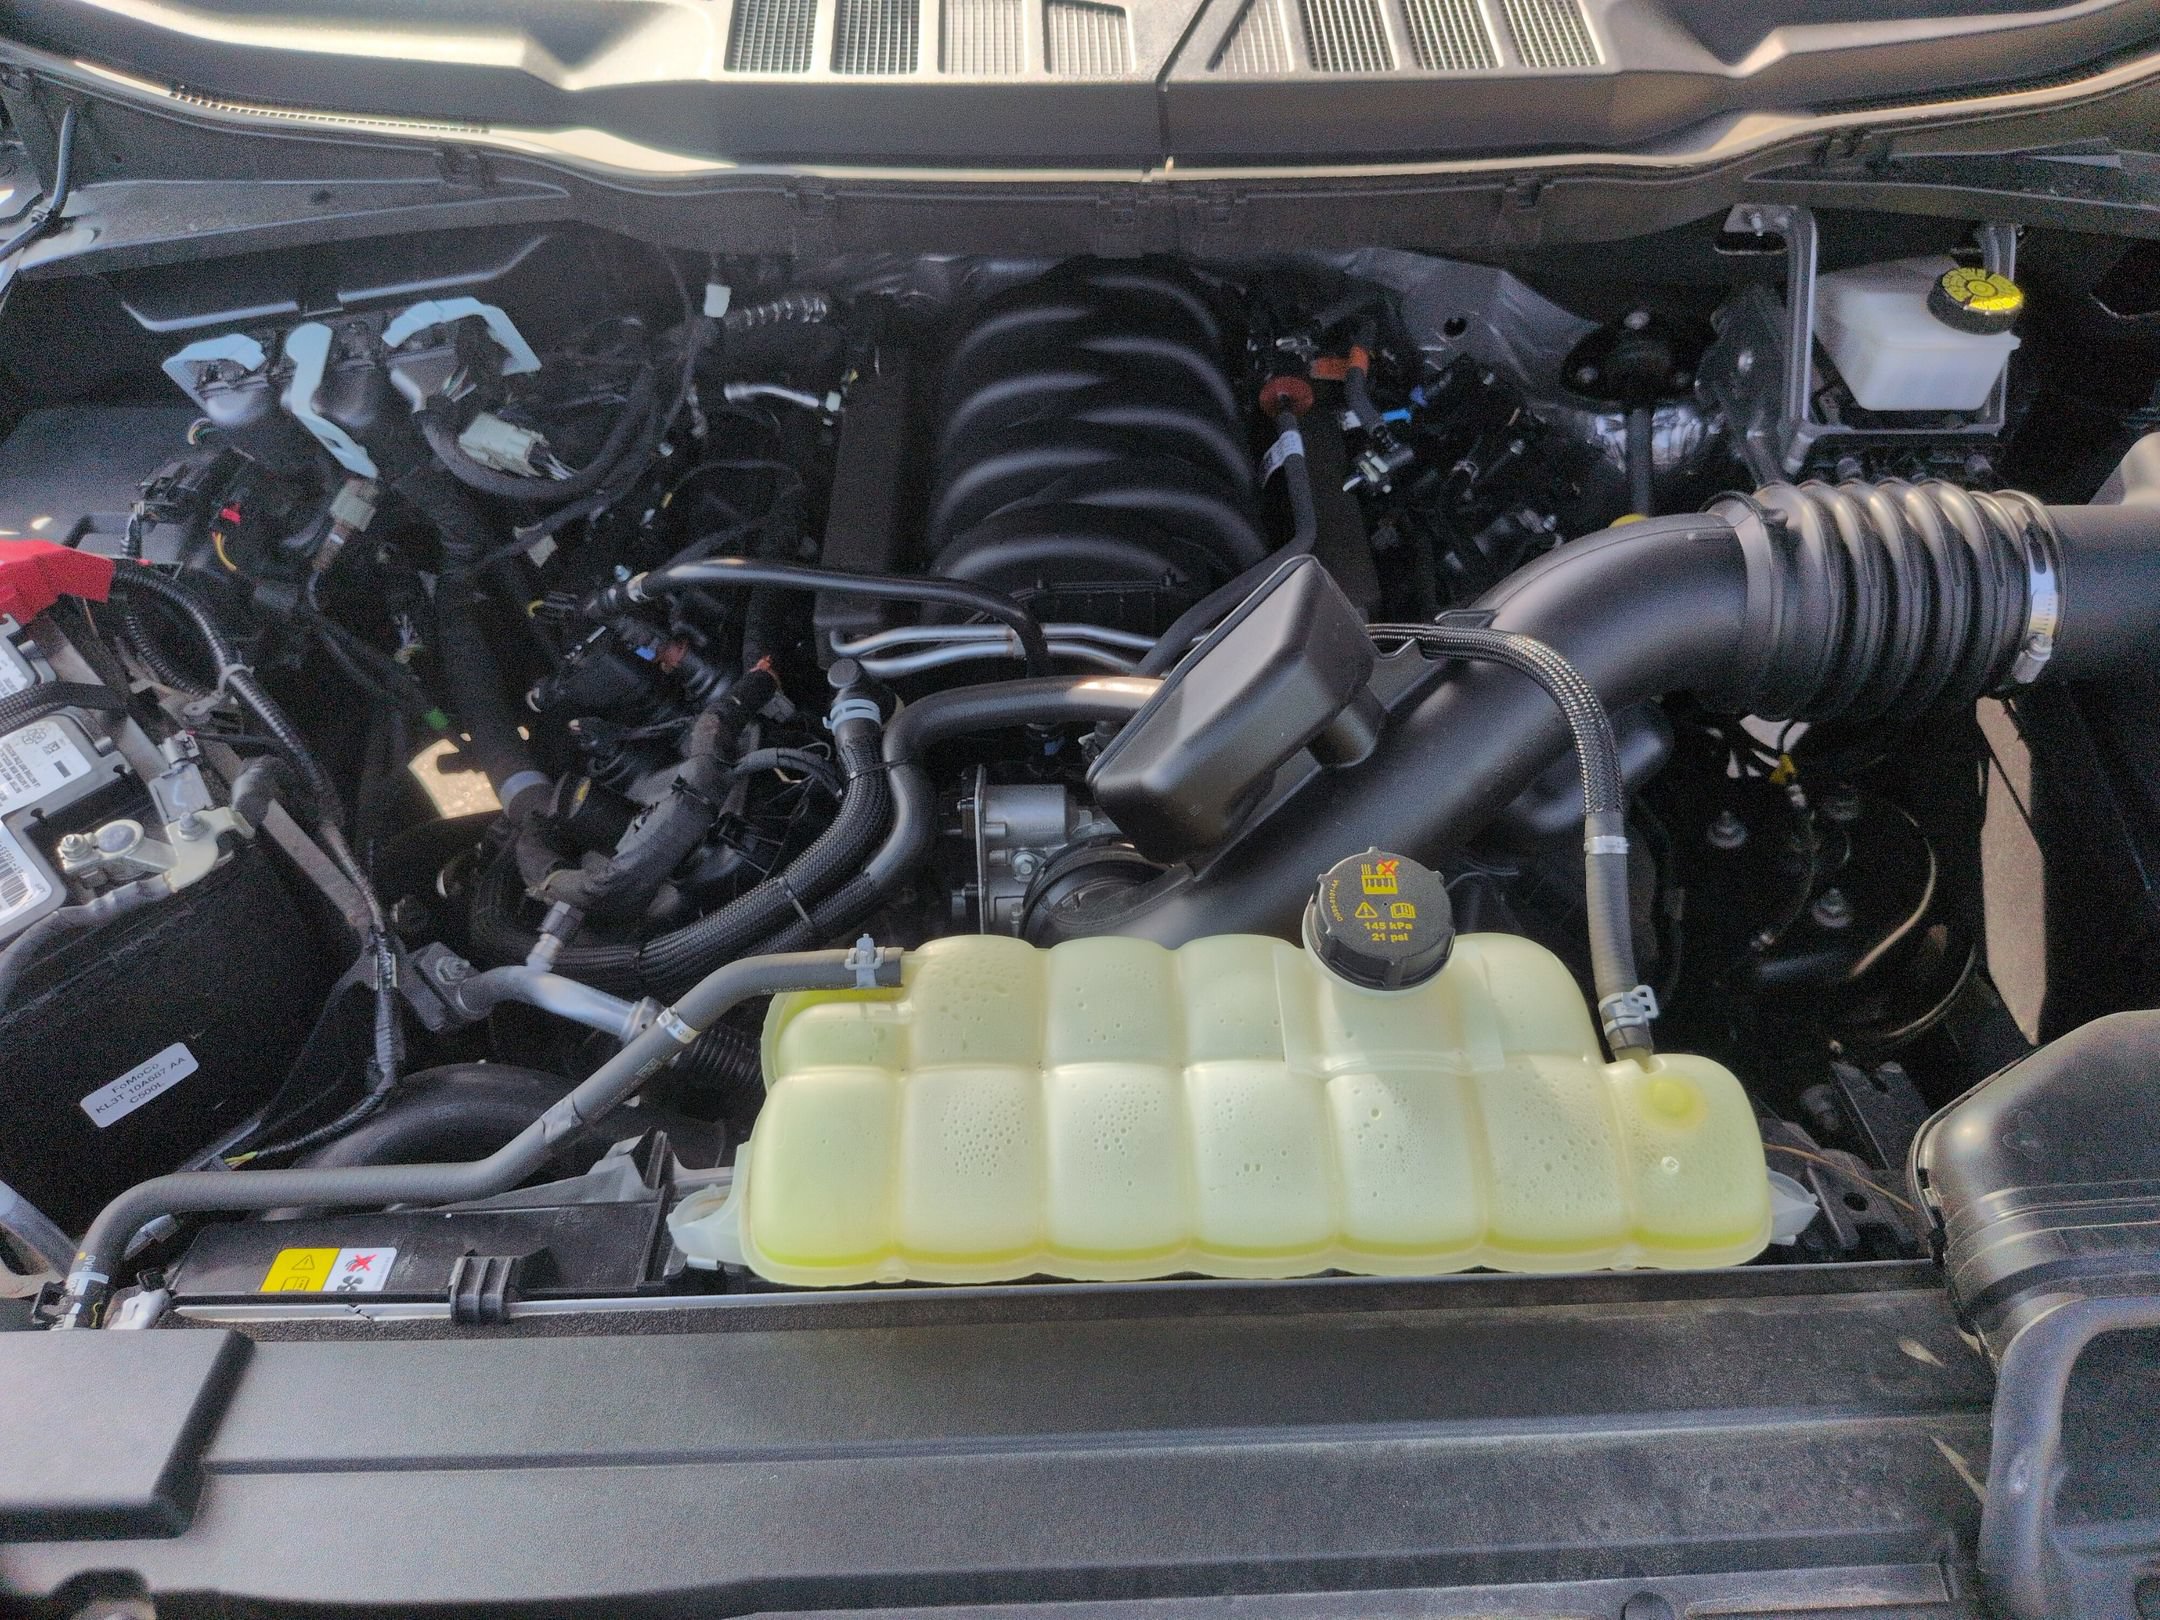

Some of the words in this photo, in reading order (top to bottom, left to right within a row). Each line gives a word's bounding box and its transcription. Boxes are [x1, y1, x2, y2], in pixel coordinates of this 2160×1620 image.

[1363, 921, 1387, 930] 145
[1389, 921, 1413, 930] kPa
[1371, 932, 1386, 941] 21
[1390, 932, 1409, 943] psi
[95, 1094, 125, 1114] KL3T
[170, 1057, 186, 1070] AA
[111, 1063, 159, 1093] FoMoCo
[82, 1254, 97, 1272] RAD
